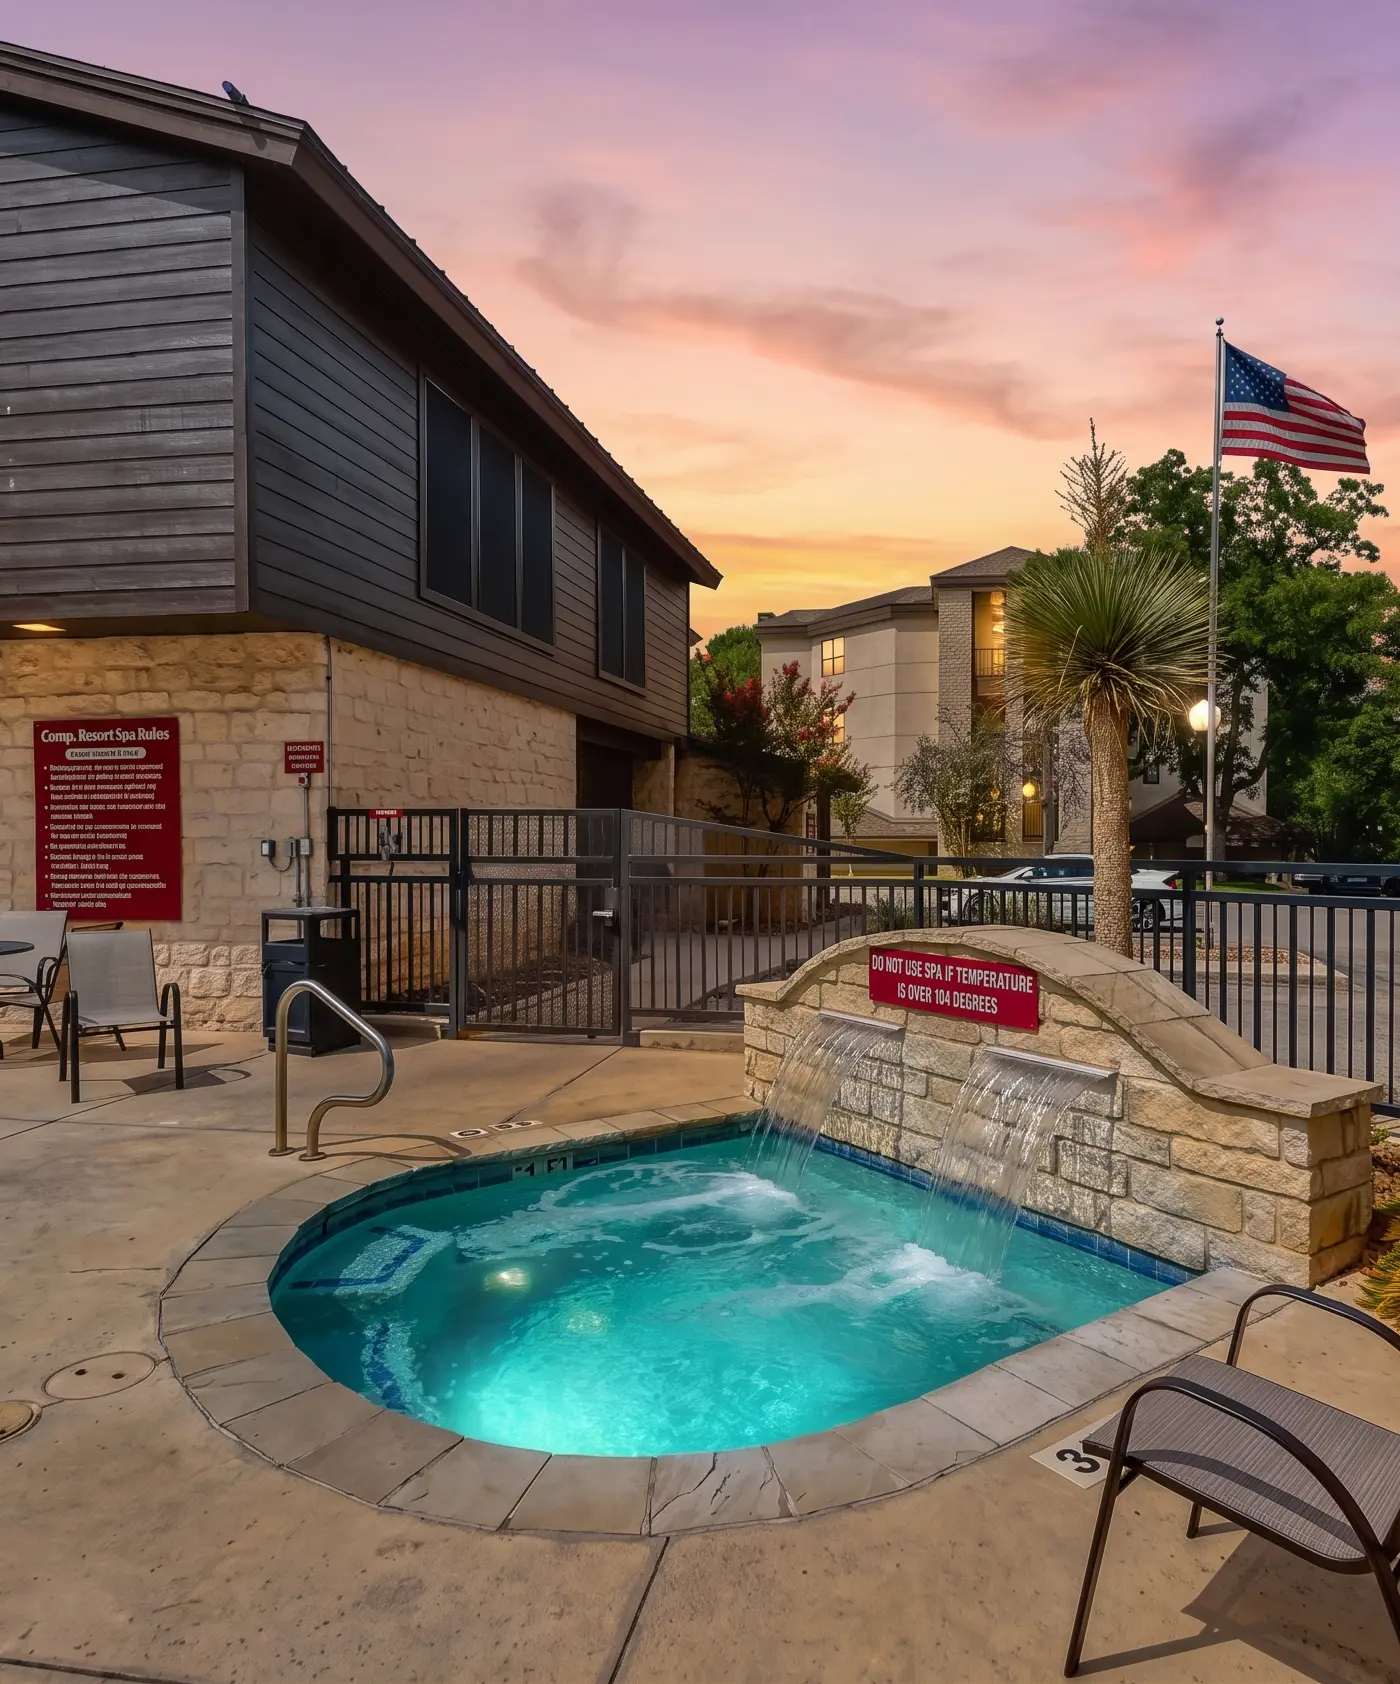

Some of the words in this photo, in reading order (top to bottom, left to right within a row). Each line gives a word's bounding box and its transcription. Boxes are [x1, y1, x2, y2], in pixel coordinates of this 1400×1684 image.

[41, 729, 77, 746] Comp.
[78, 728, 115, 742] Resort
[115, 727, 136, 743] Spa
[137, 726, 170, 740] Rules
[871, 954, 884, 971] DO
[885, 956, 903, 974] NOT
[905, 959, 923, 978] USE
[924, 962, 943, 981] SPA
[945, 965, 954, 982] IF
[955, 966, 1034, 994] TEMPERATURE
[897, 982, 906, 999] IS
[908, 984, 932, 1004] OVER
[934, 988, 950, 1006] 104
[953, 991, 998, 1015] DEGREES
[1055, 1448, 1101, 1474] 3
